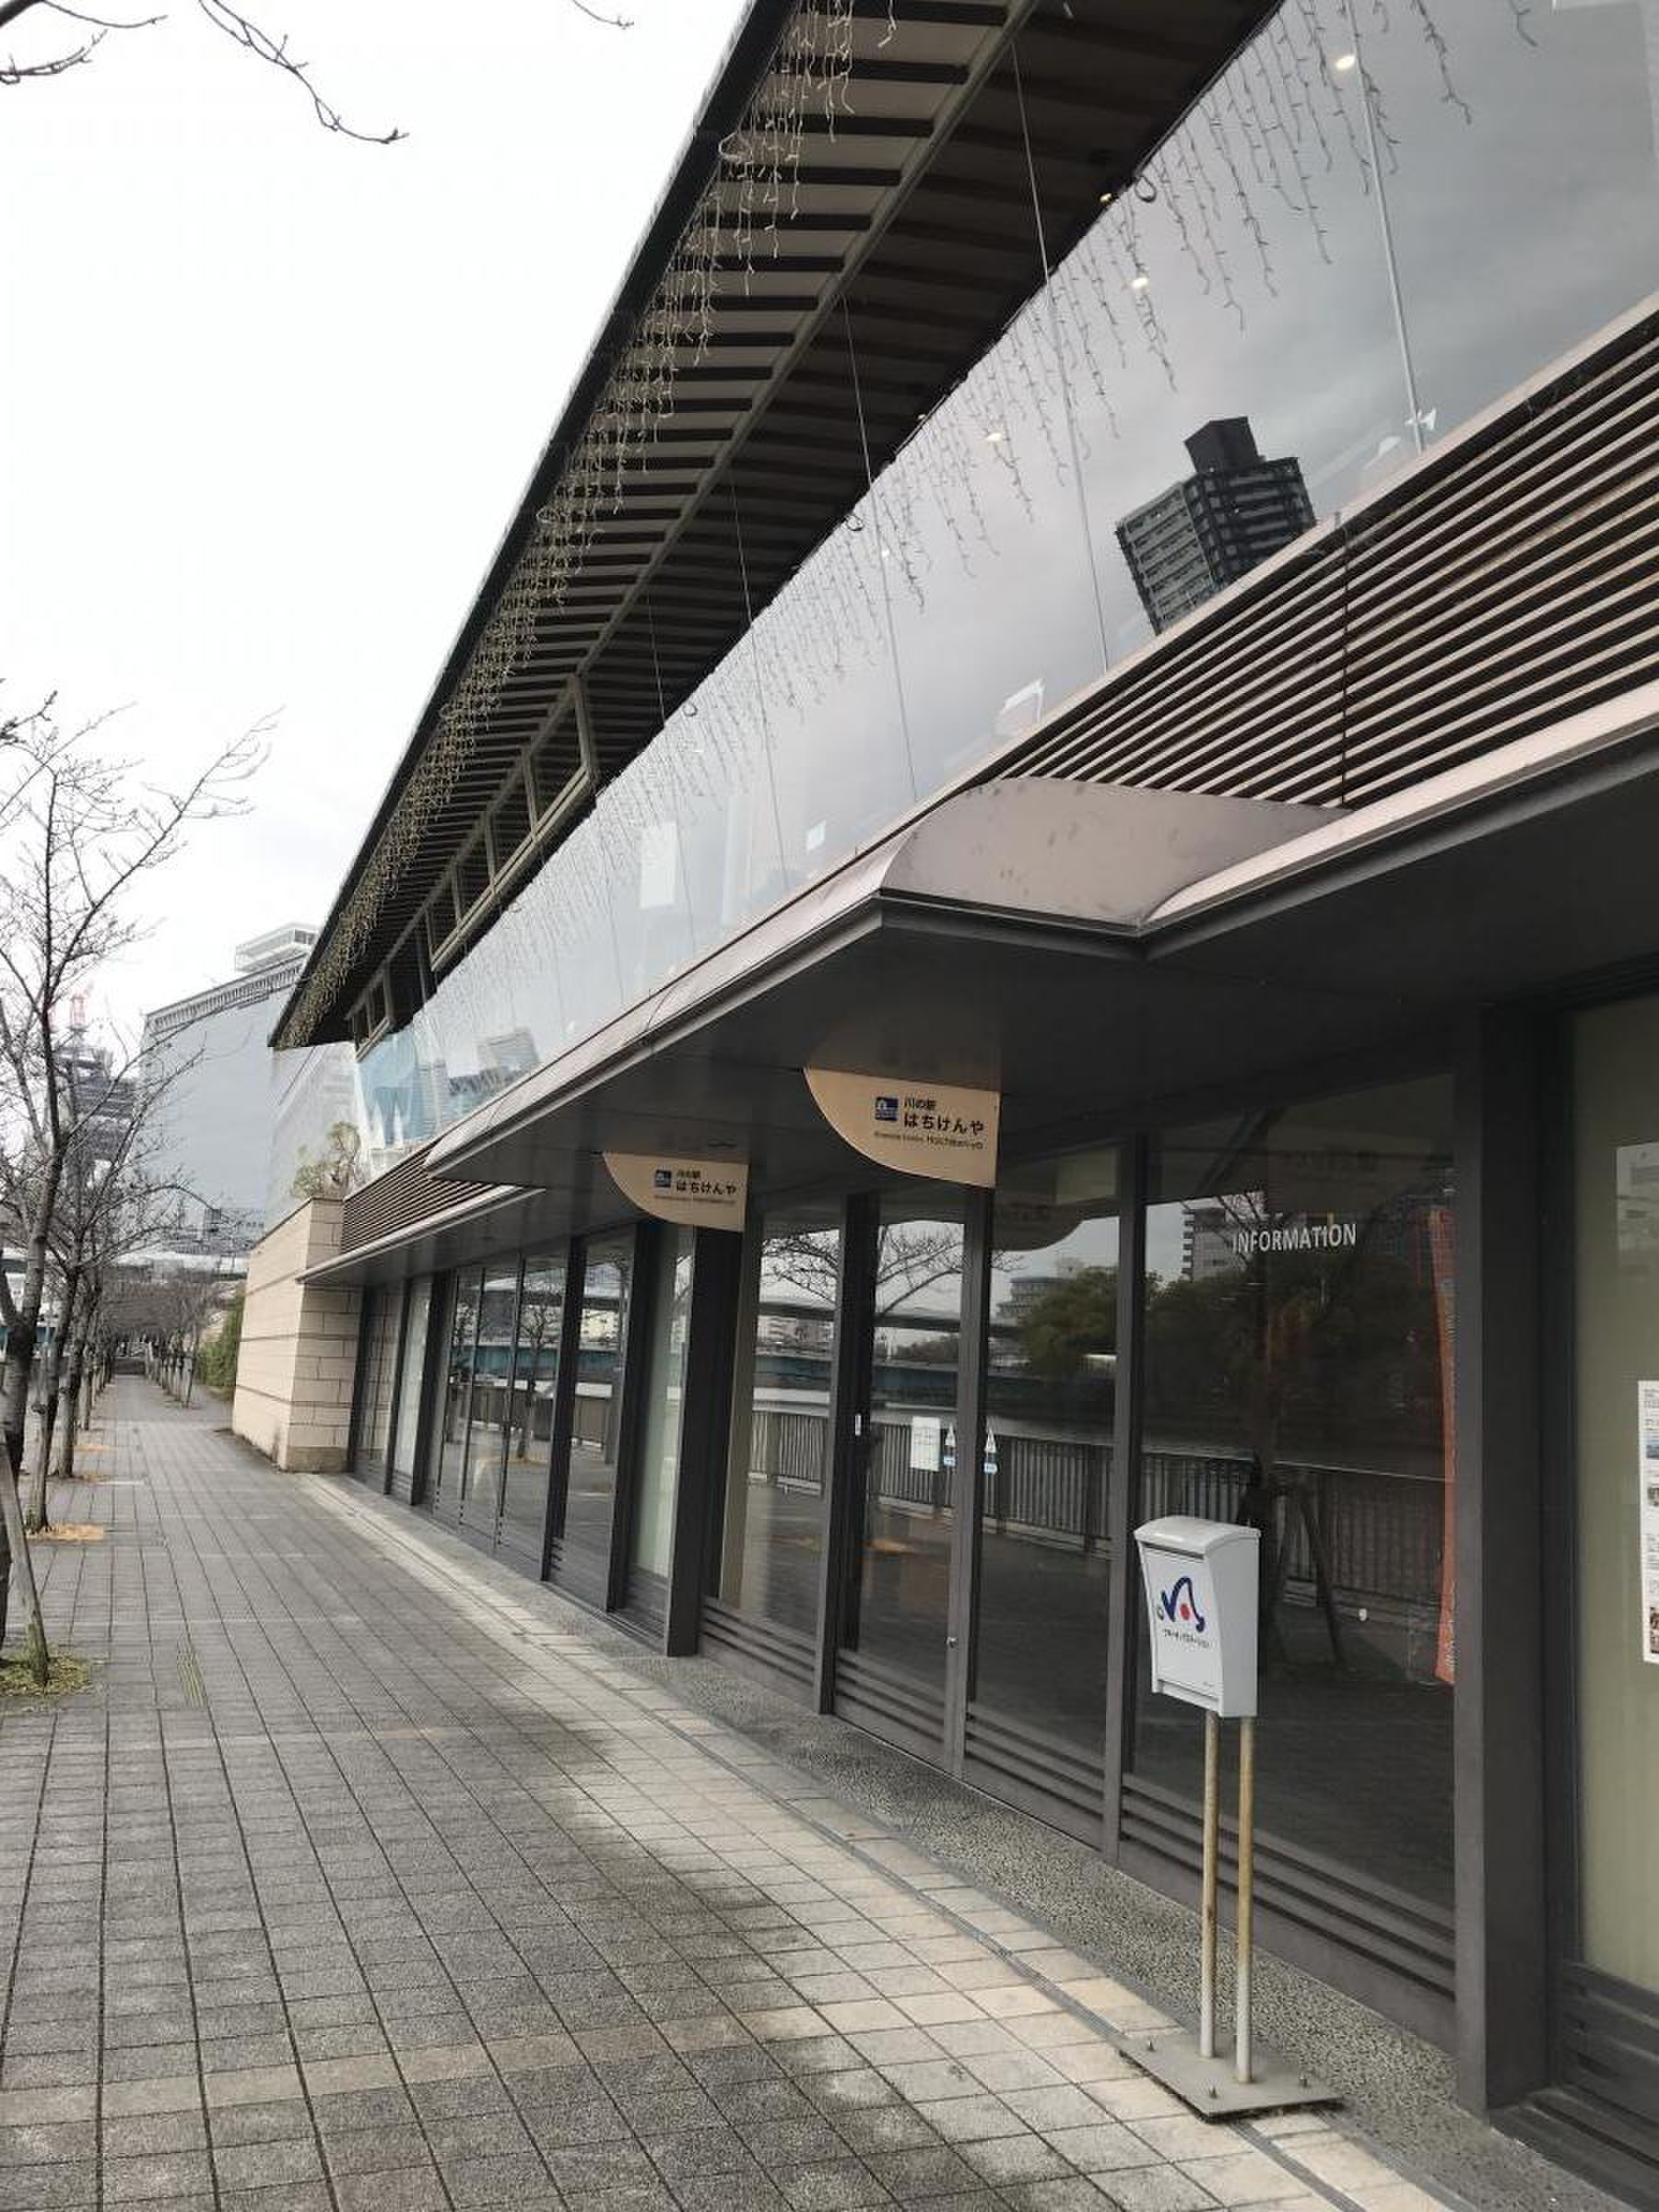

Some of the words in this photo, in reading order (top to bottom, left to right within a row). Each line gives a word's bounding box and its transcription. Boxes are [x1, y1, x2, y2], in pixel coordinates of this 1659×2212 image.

[904, 1112, 984, 1136] はちけんや
[676, 1180, 737, 1196] はちけんや
[1231, 1222, 1357, 1254] INFORMATION
